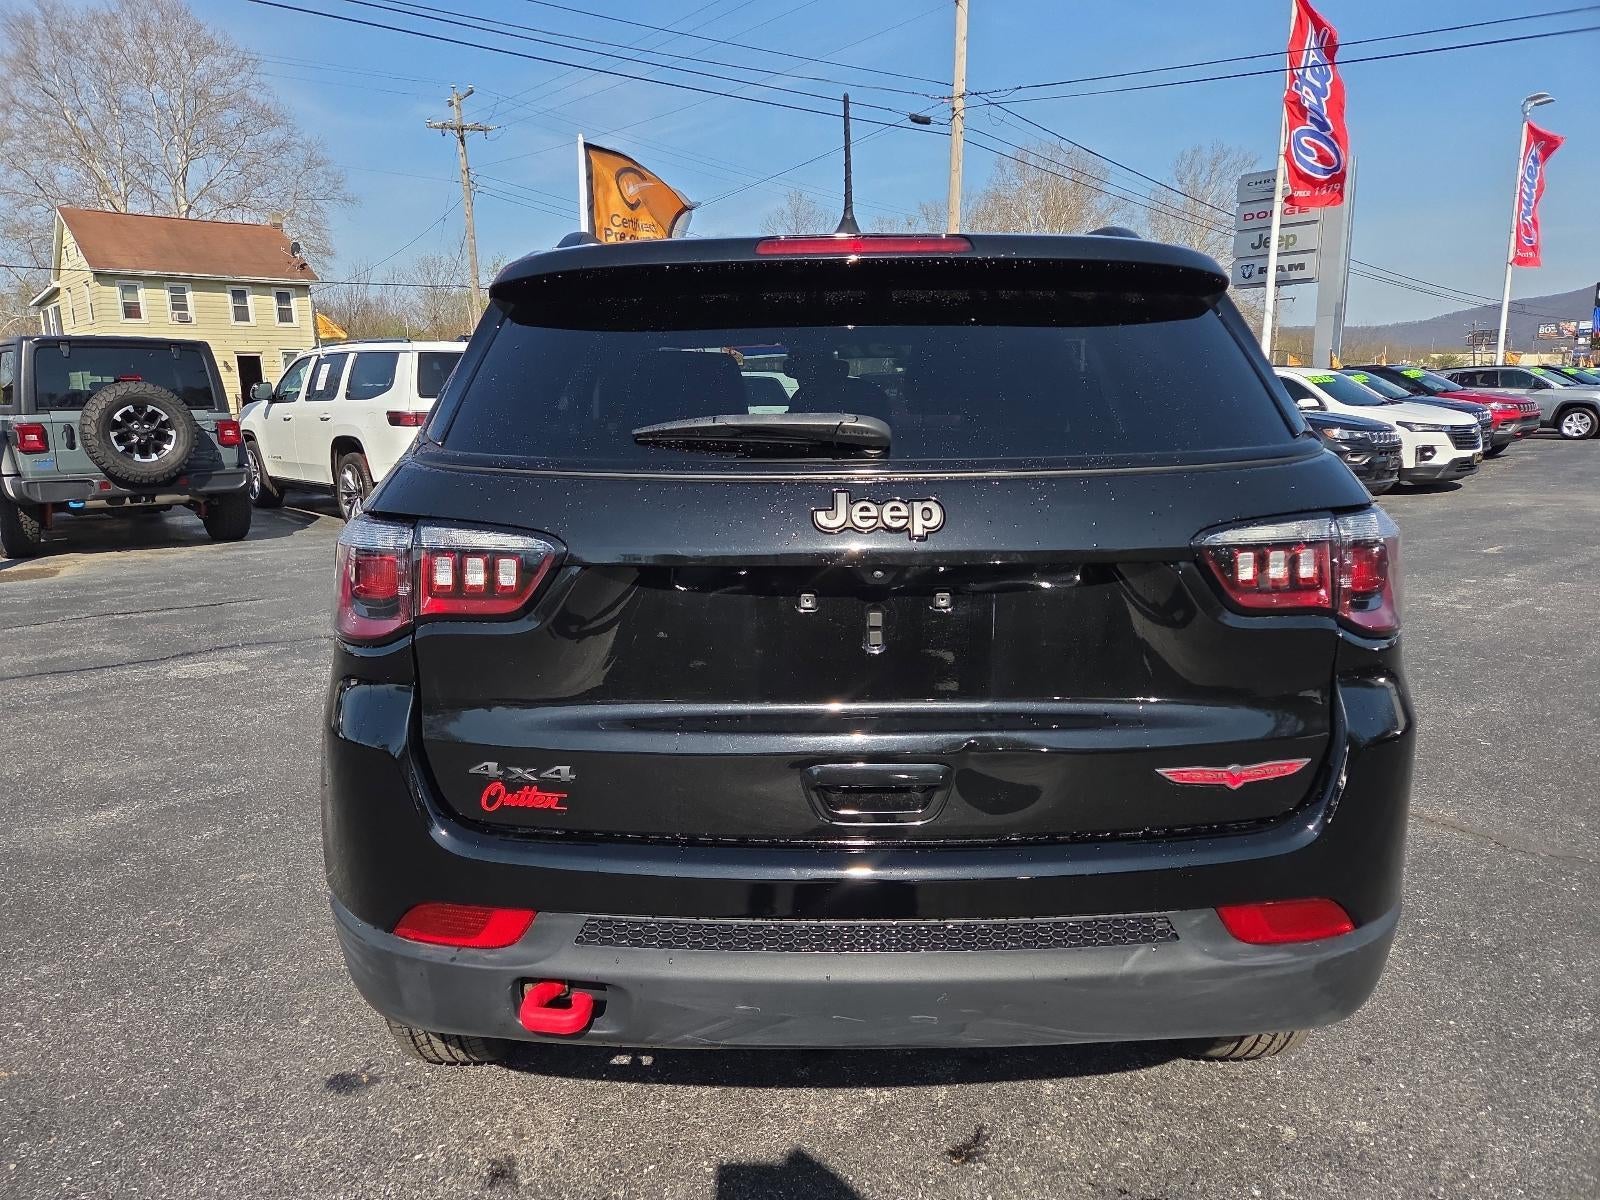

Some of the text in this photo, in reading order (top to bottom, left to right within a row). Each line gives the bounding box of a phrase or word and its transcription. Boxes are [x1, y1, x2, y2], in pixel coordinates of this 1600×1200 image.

[1247, 177, 1276, 187] CHRY
[1243, 207, 1310, 222] DOGE
[1251, 233, 1297, 250] Jeep
[1258, 262, 1305, 275] RAM
[813, 490, 945, 540] Jeep
[468, 761, 576, 782] 4x4
[480, 781, 568, 812] Outten
